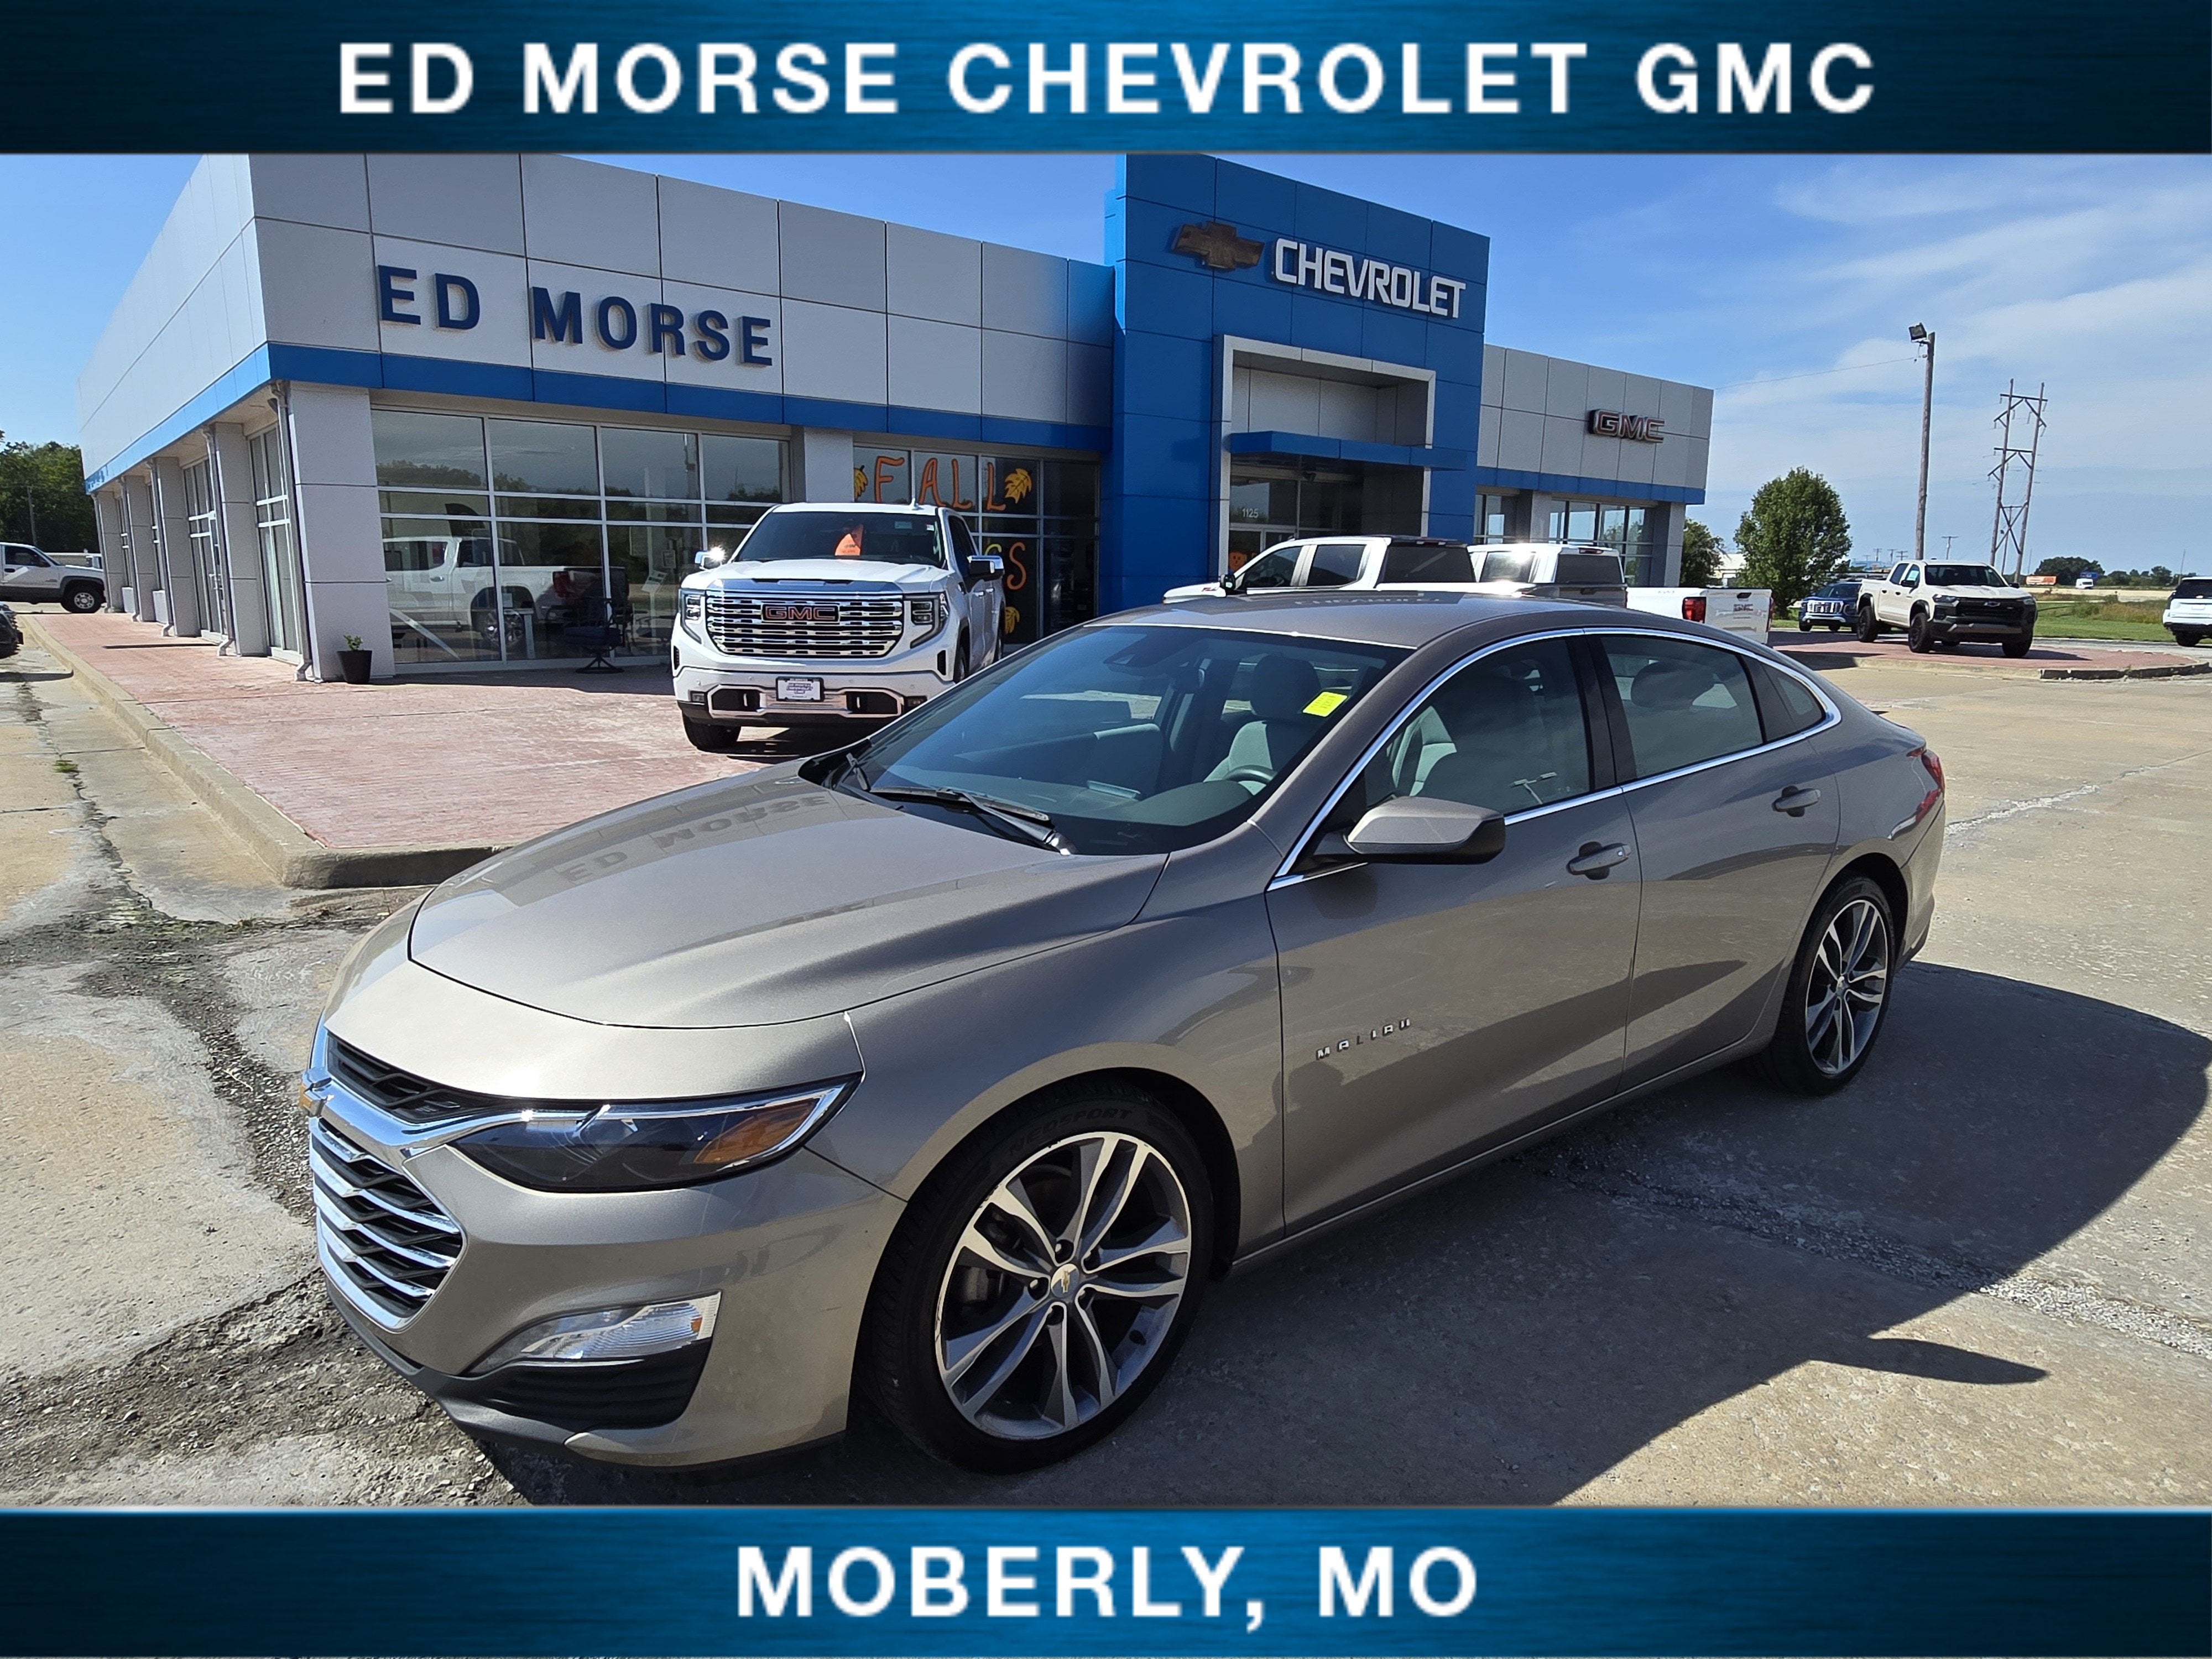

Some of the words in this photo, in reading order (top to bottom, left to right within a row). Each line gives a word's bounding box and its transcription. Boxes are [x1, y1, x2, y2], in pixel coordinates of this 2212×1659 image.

[1275, 238, 1466, 319] CHEVROLET
[378, 264, 480, 331] ED
[531, 286, 773, 366] MORSE
[1594, 409, 1665, 444] GMC
[874, 456, 1006, 511] FALL
[1242, 508, 1259, 518] 1125
[765, 606, 836, 620] GMC
[1316, 1018, 1411, 1060] MALIBU
